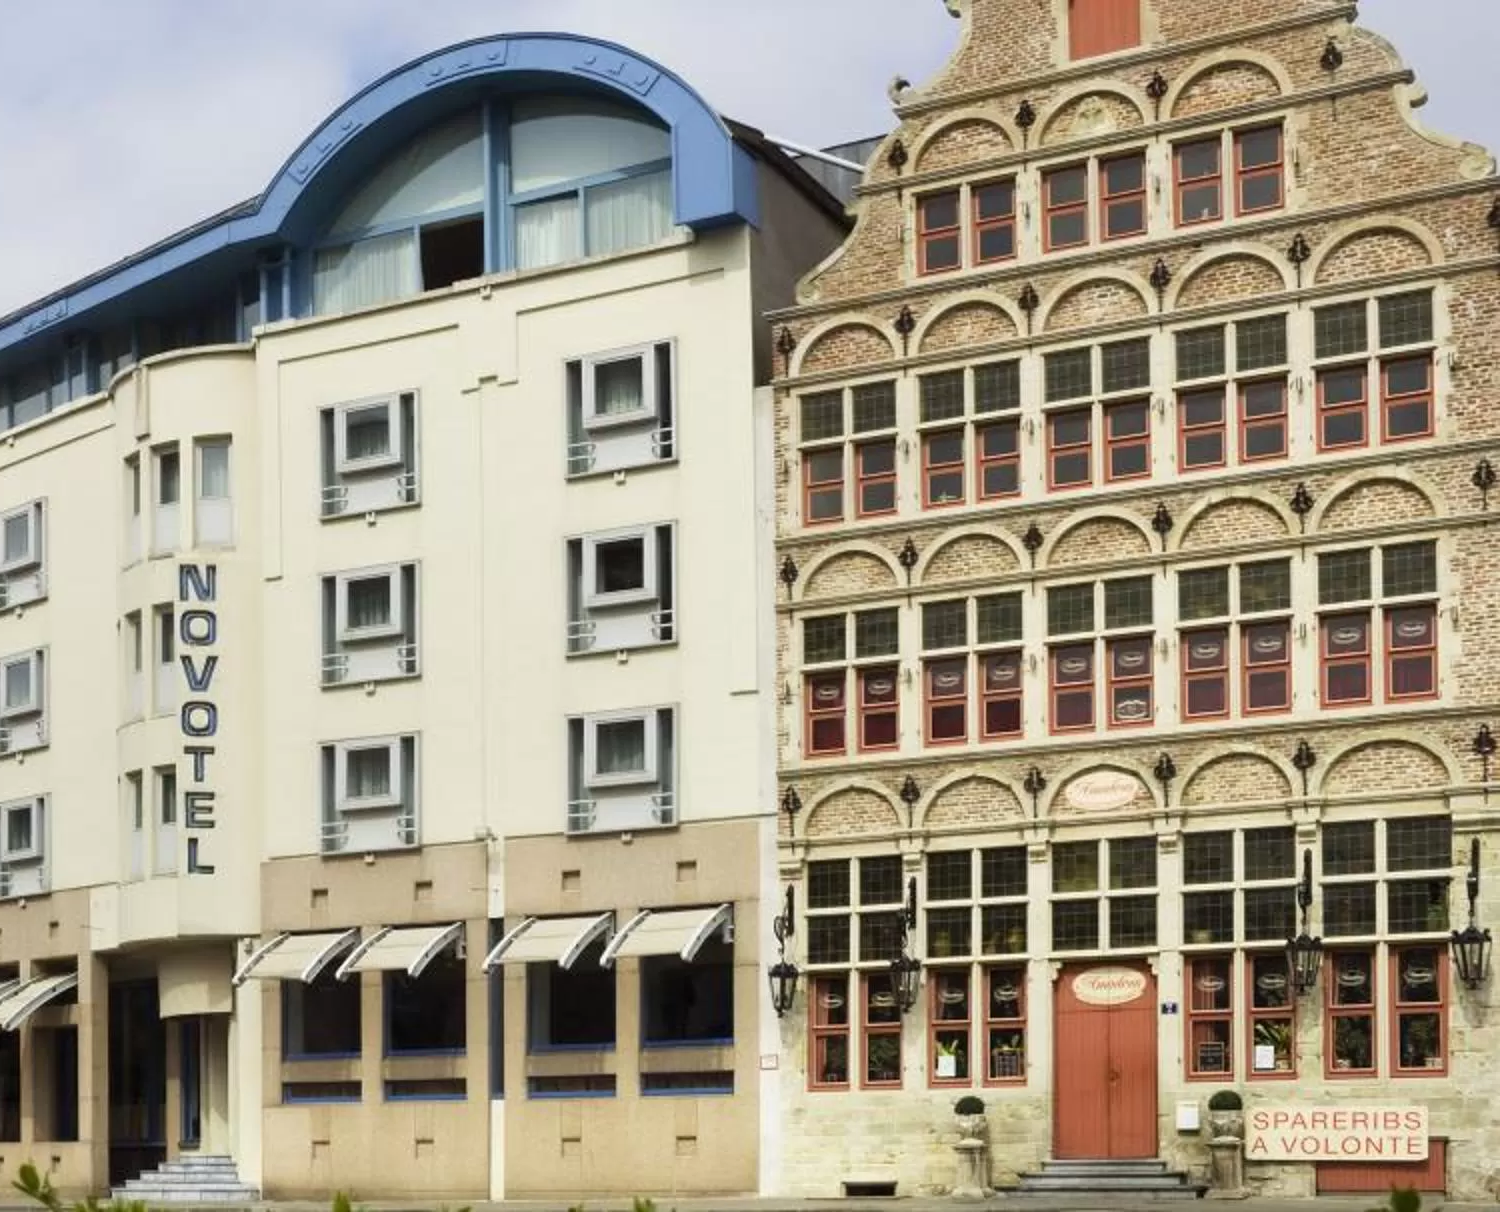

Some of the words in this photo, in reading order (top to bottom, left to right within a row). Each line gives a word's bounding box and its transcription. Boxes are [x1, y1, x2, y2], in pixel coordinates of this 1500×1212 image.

[178, 564, 218, 875] NOVOTEL
[1252, 1111, 1422, 1131] SPARERIBS
[1251, 1136, 1268, 1154] A
[1280, 1136, 1423, 1155] VOLONTE
